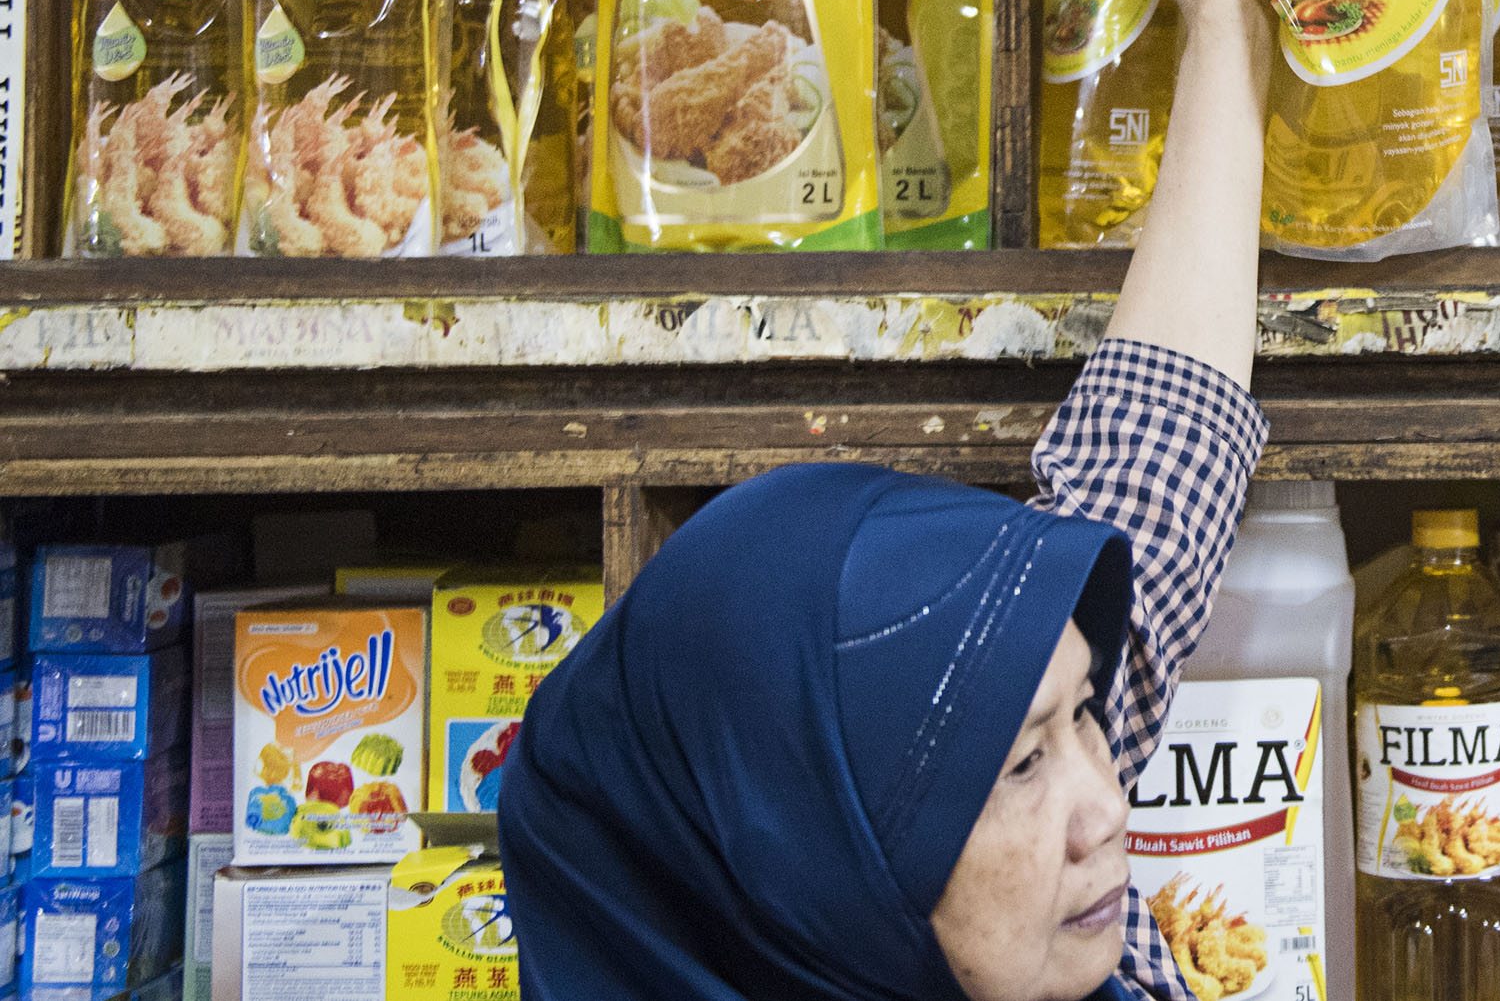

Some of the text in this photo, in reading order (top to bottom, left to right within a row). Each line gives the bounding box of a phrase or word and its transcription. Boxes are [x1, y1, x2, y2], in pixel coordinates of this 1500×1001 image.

[1108, 108, 1150, 146] SNI
[468, 232, 492, 254] 1L
[261, 629, 393, 715] Nutrijell
[1174, 718, 1229, 730] GORENG
[1135, 828, 1252, 853] Buah Sawit Pilihan
